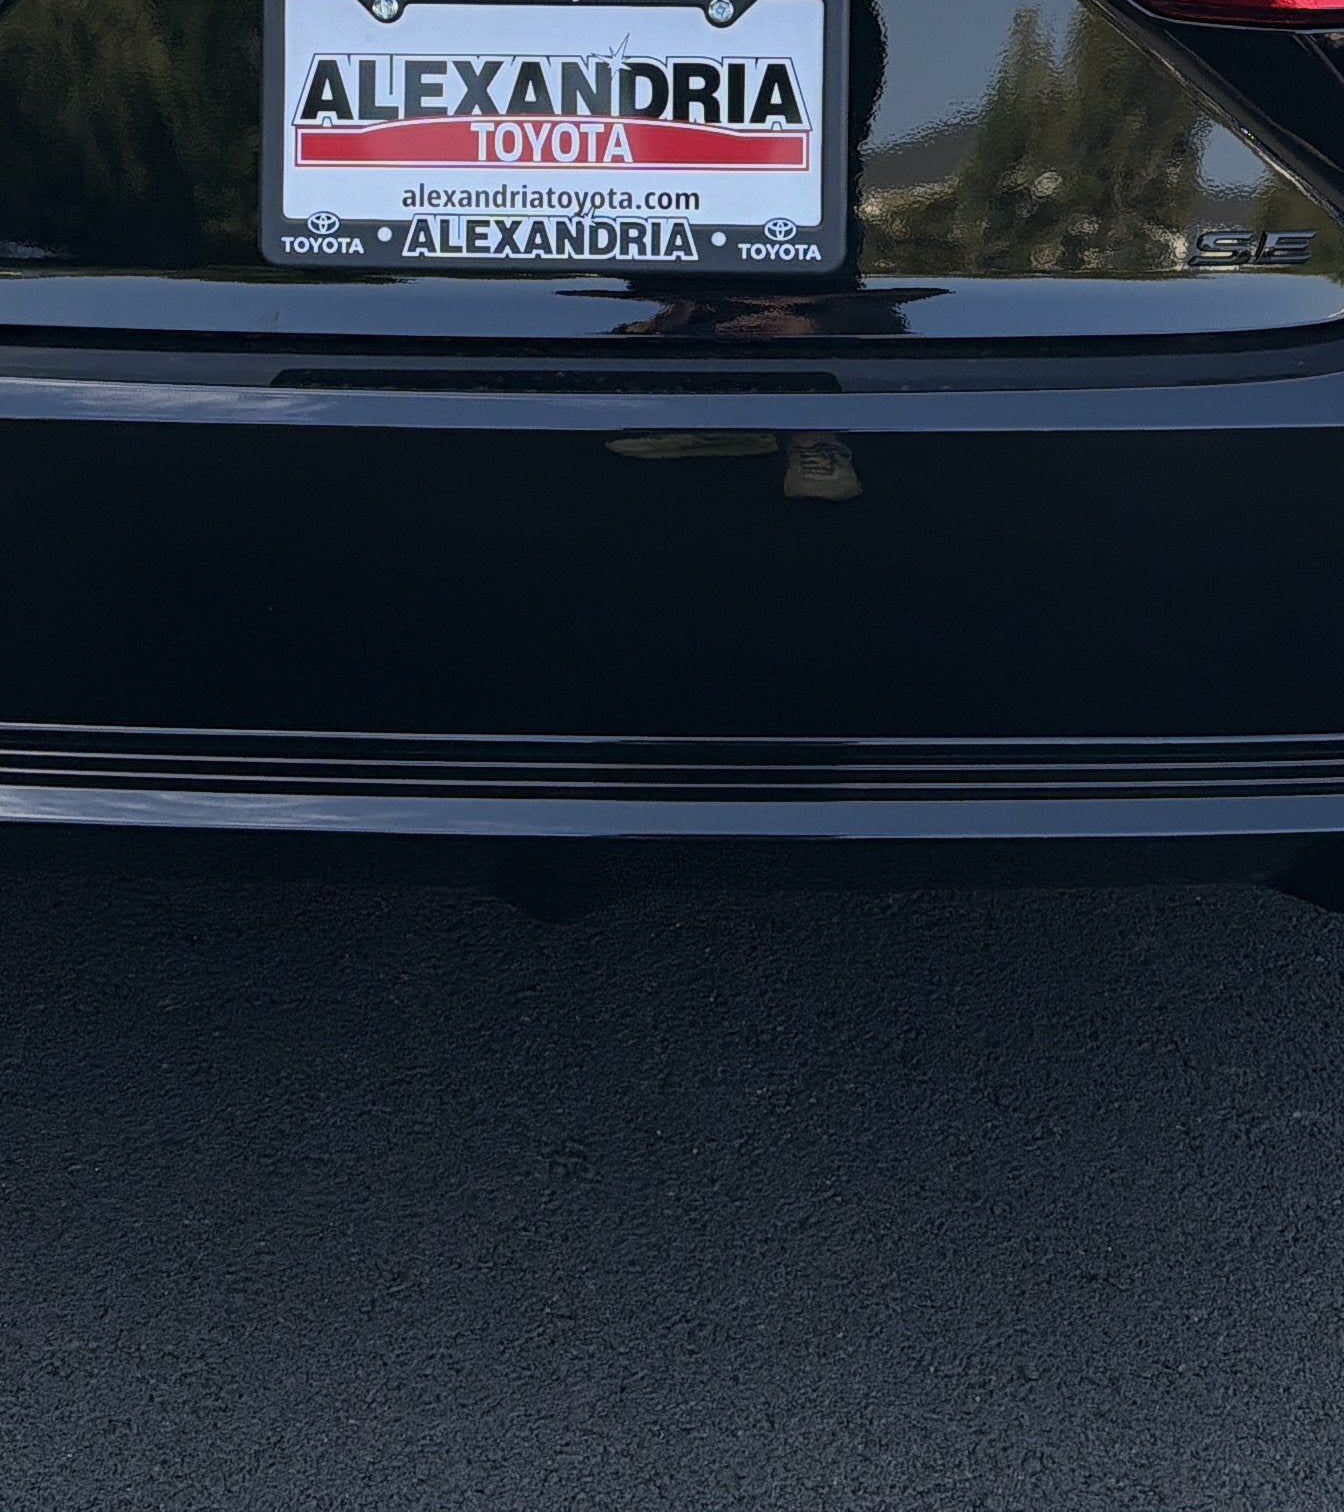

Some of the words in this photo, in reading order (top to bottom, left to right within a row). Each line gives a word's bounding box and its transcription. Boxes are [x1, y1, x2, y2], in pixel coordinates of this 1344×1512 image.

[300, 58, 806, 125] ALEXANDRIA
[471, 122, 633, 163] TOYOTA
[401, 182, 701, 212] alexandriatoyota.com
[281, 236, 364, 254] TOYOTA
[405, 218, 696, 258] ALEXANDRIA
[738, 242, 821, 261] TOYOTA
[1188, 230, 1317, 266] SE
